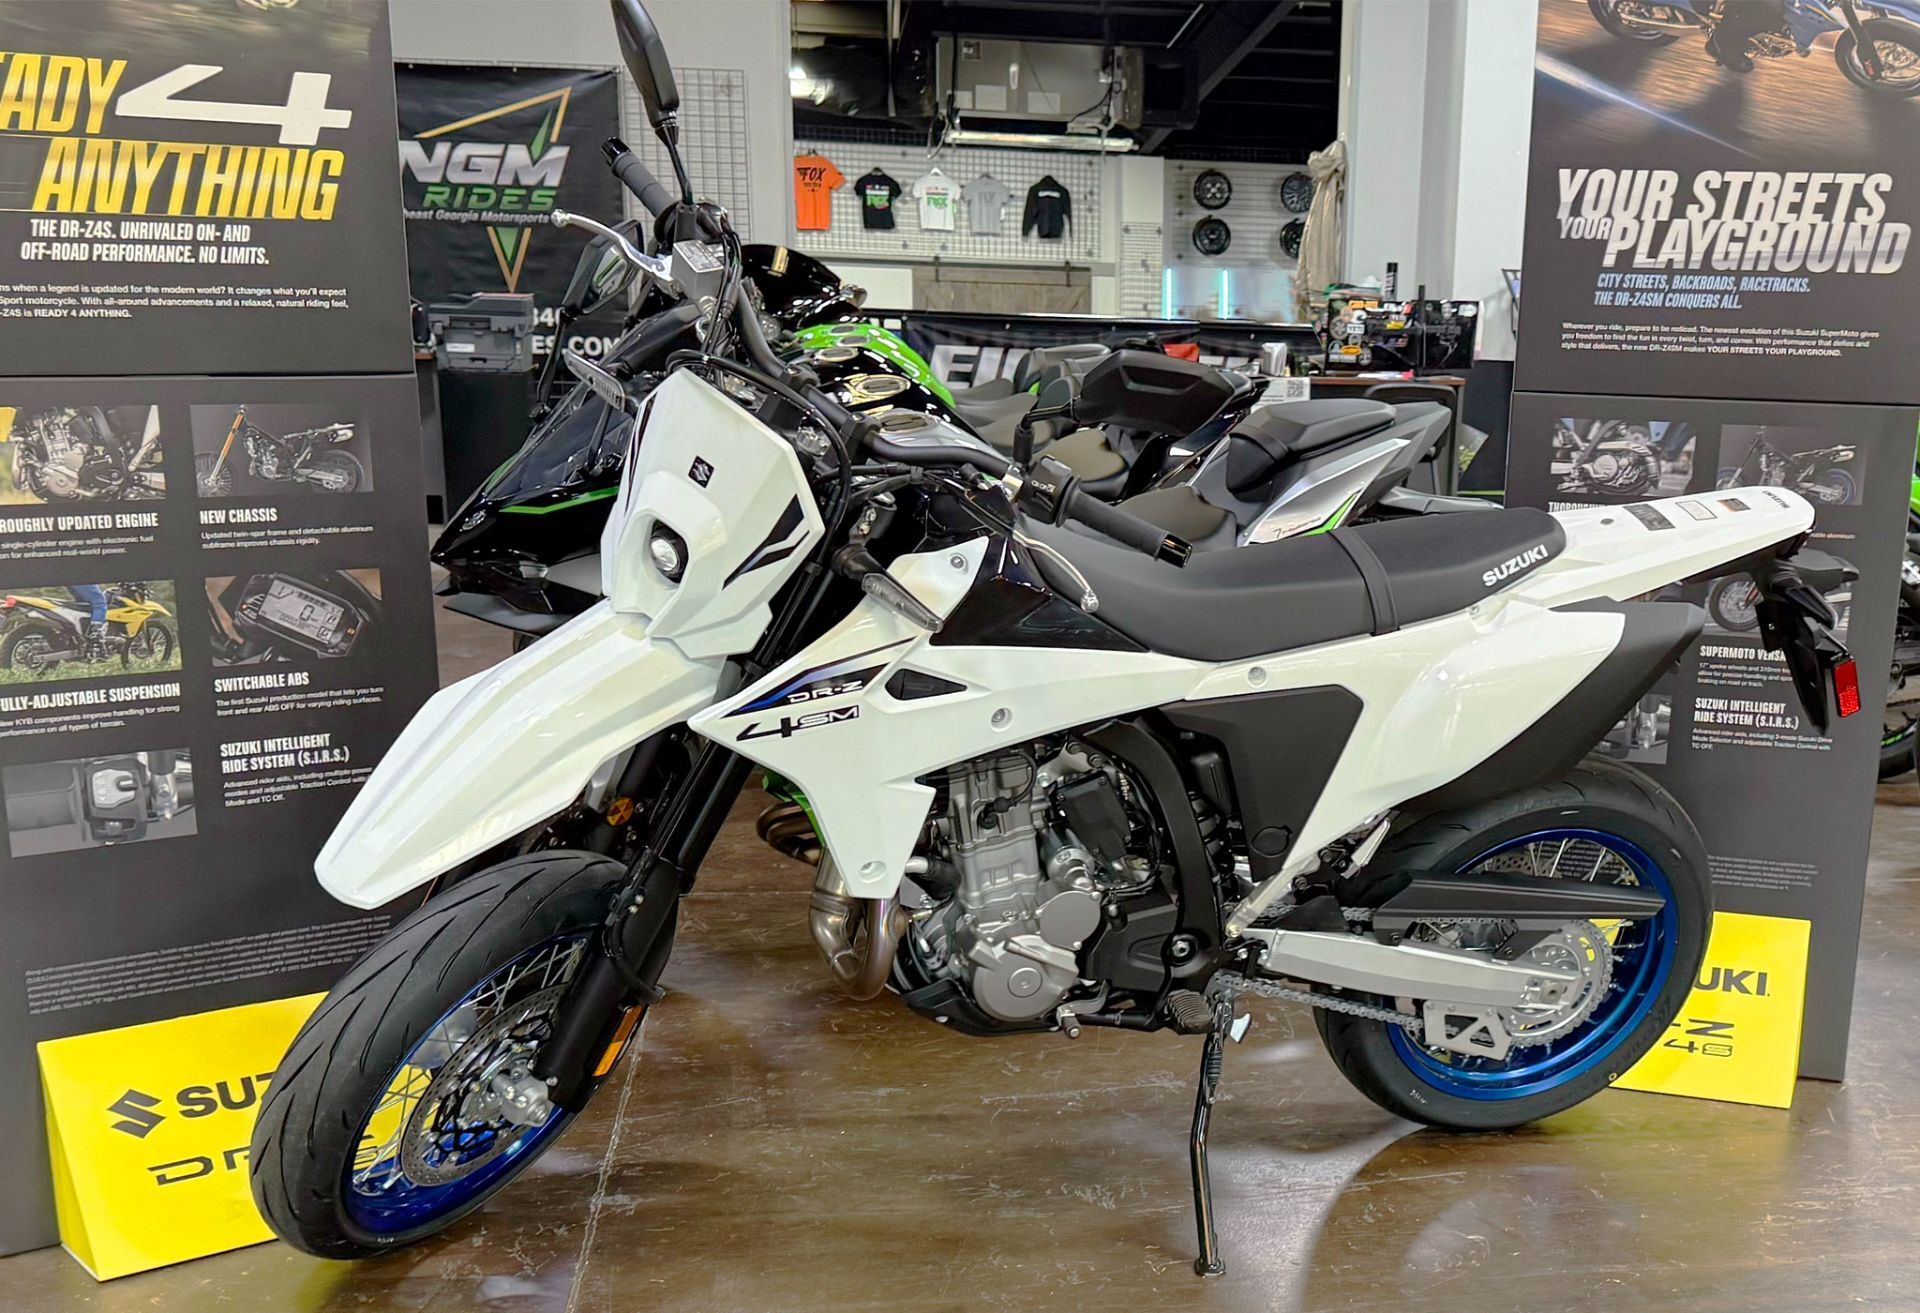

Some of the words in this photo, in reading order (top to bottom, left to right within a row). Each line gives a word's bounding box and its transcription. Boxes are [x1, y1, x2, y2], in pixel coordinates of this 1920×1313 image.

[0, 52, 127, 133] ADY
[115, 64, 352, 145] 4
[400, 140, 570, 186] NGM
[33, 138, 344, 220] ANYTHING
[797, 167, 826, 181] FOX
[422, 185, 557, 212] RIDES
[1557, 169, 1678, 221] YOUR
[1686, 171, 1892, 226] STREETS
[436, 210, 477, 224] Georgia
[481, 211, 550, 225] Motorsports
[30, 219, 57, 238] THE
[60, 220, 117, 239] DR-Z4S.
[120, 222, 193, 241] UNRIVALED
[196, 225, 221, 241] ON-
[223, 225, 250, 242] AND
[21, 242, 89, 261] OFF-ROAD
[92, 243, 196, 263] PERFORMANCE.
[199, 246, 217, 263] NO
[220, 247, 270, 265] LIMITS.
[1559, 217, 1613, 239] YOUR
[1601, 217, 1912, 274] PLAYGROUND
[12, 284, 38, 292] when
[48, 284, 79, 294] legend
[81, 284, 89, 293] is
[91, 285, 128, 294] updated
[131, 285, 143, 293] for
[145, 285, 159, 293] the
[161, 286, 195, 294] modern
[197, 286, 225, 294] world?
[228, 286, 234, 294] It
[236, 287, 271, 296] changes
[295, 288, 317, 297] you'll
[319, 288, 346, 297] expect
[1597, 273, 1622, 288] CITY
[1623, 274, 1670, 291] STREETS,
[1672, 275, 1737, 292] BACKROADS,
[1740, 277, 1810, 293] RACETRACKS.
[26, 297, 79, 306] motorcycle.
[81, 297, 102, 305] With
[104, 297, 148, 305] all-around
[151, 298, 213, 306] advancements
[216, 298, 232, 306] and
[241, 299, 274, 308] relaxed,
[276, 299, 304, 307] natural
[307, 299, 329, 308] riding
[331, 299, 349, 308] feel,
[1594, 292, 1613, 305] THE
[1613, 292, 1664, 307] DR-Z4SM
[1665, 293, 1720, 309] CONQUERS
[1721, 294, 1742, 309] ALL.
[24, 309, 33, 317] is
[34, 309, 69, 317] READY
[70, 309, 77, 317] 4
[79, 309, 132, 318] ANYTHING.
[0, 517, 54, 533] ROUGHLY
[57, 514, 112, 531] UPDATED
[116, 512, 159, 528] ENGINE
[200, 510, 226, 524] NEW
[229, 507, 278, 523] CHASSIS
[1482, 544, 1549, 588] SUZUKI
[1700, 645, 1755, 660] SUPERMOTO
[109, 682, 181, 702] SUSPENSION
[214, 674, 285, 693] SWITCHABLE
[288, 671, 310, 686] ABS
[787, 680, 863, 704] DR-Z
[1695, 697, 1728, 710] SUZUKI
[1730, 700, 1786, 715] INTELLIGENT
[1694, 712, 1716, 723] RIDE
[1717, 713, 1753, 726] SYSTEM
[1755, 714, 1800, 730] (S.I.R.S.)
[220, 743, 261, 757] SUZUKI
[263, 733, 330, 753] INTELLIGENT
[222, 758, 248, 774] RIDE
[250, 754, 295, 771] SYSTEM
[298, 746, 350, 767] (S.I.R.S.)
